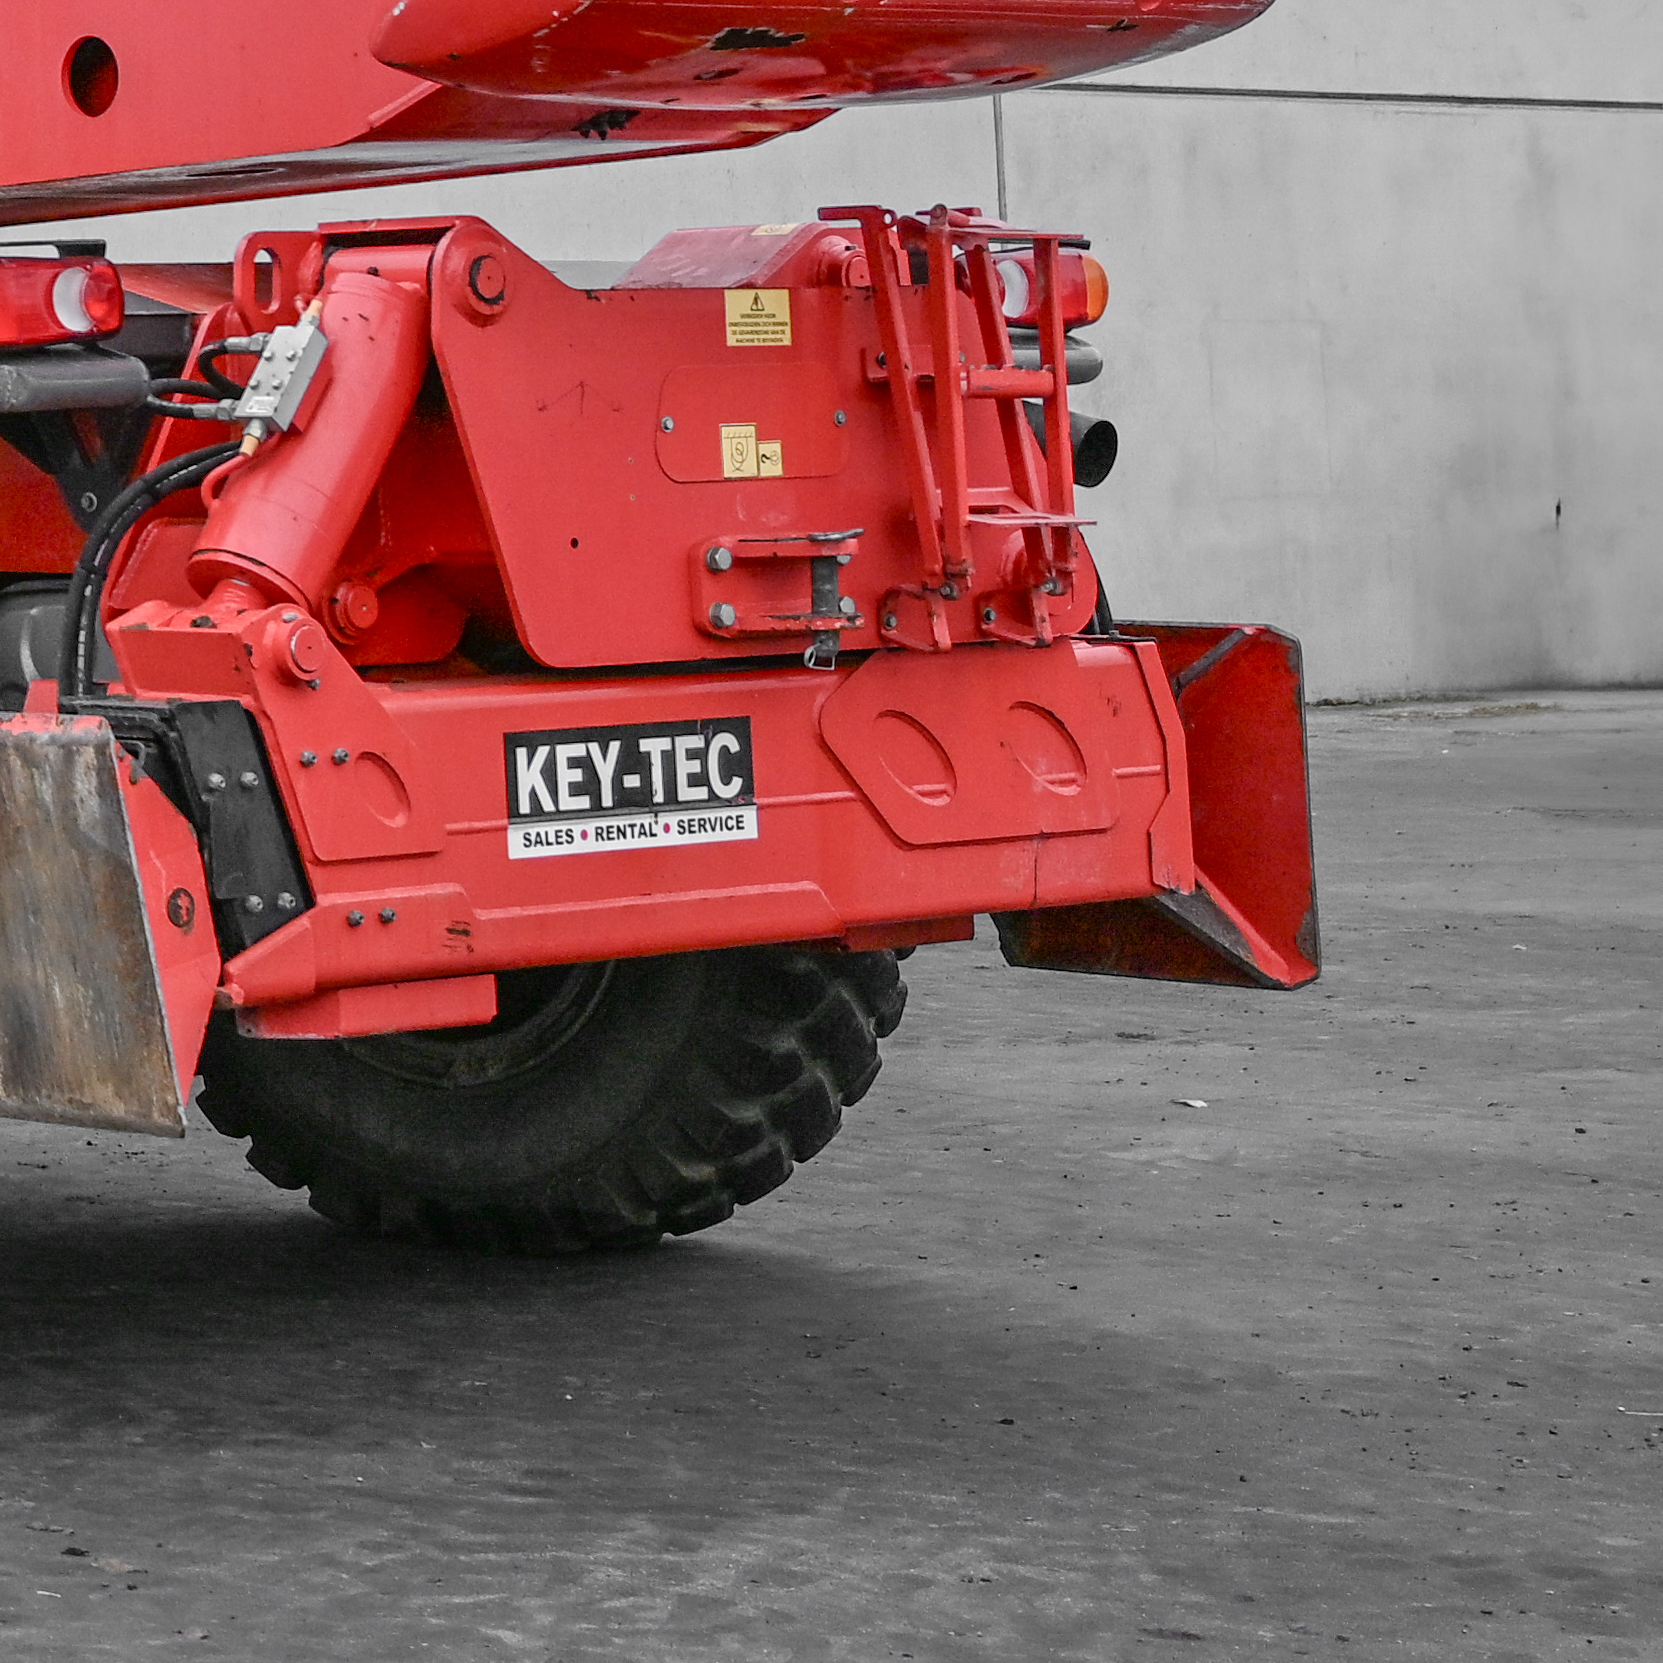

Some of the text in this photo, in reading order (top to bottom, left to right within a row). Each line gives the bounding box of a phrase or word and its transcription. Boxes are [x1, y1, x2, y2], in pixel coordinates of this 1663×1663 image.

[515, 732, 743, 815] KEY-TEC
[523, 814, 745, 848] SALES RENTAL SERVICE
